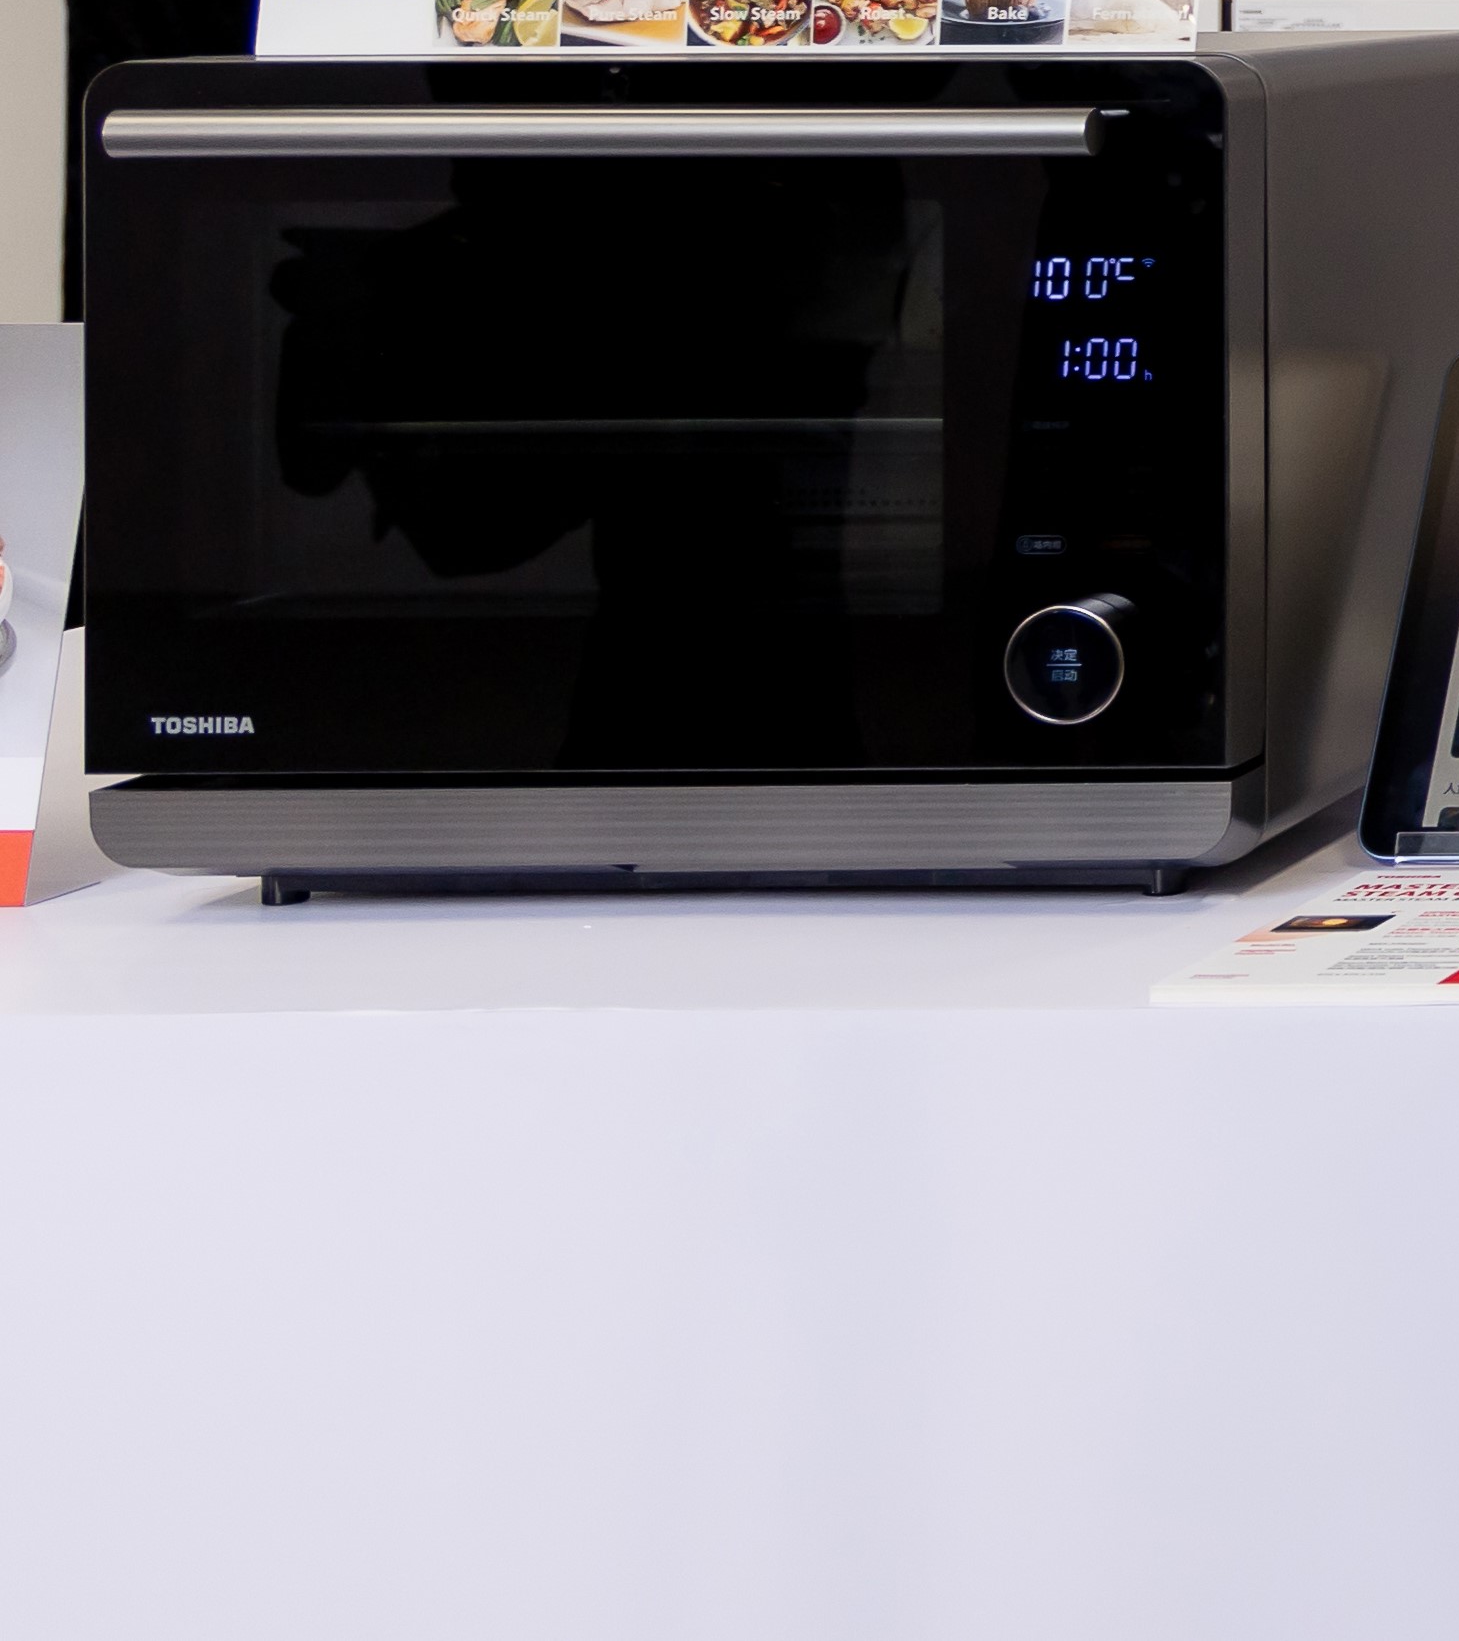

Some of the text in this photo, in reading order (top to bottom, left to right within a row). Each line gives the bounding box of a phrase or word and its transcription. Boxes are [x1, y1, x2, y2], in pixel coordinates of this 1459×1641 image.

[452, 9, 498, 23] Quick
[588, 8, 678, 22] Pure Steam
[710, 8, 801, 22] Slow Steam
[860, 7, 905, 20] Roast
[987, 6, 1028, 20] Bake
[1062, 337, 1138, 380] 1:00
[151, 717, 255, 734] TOSHIBA
